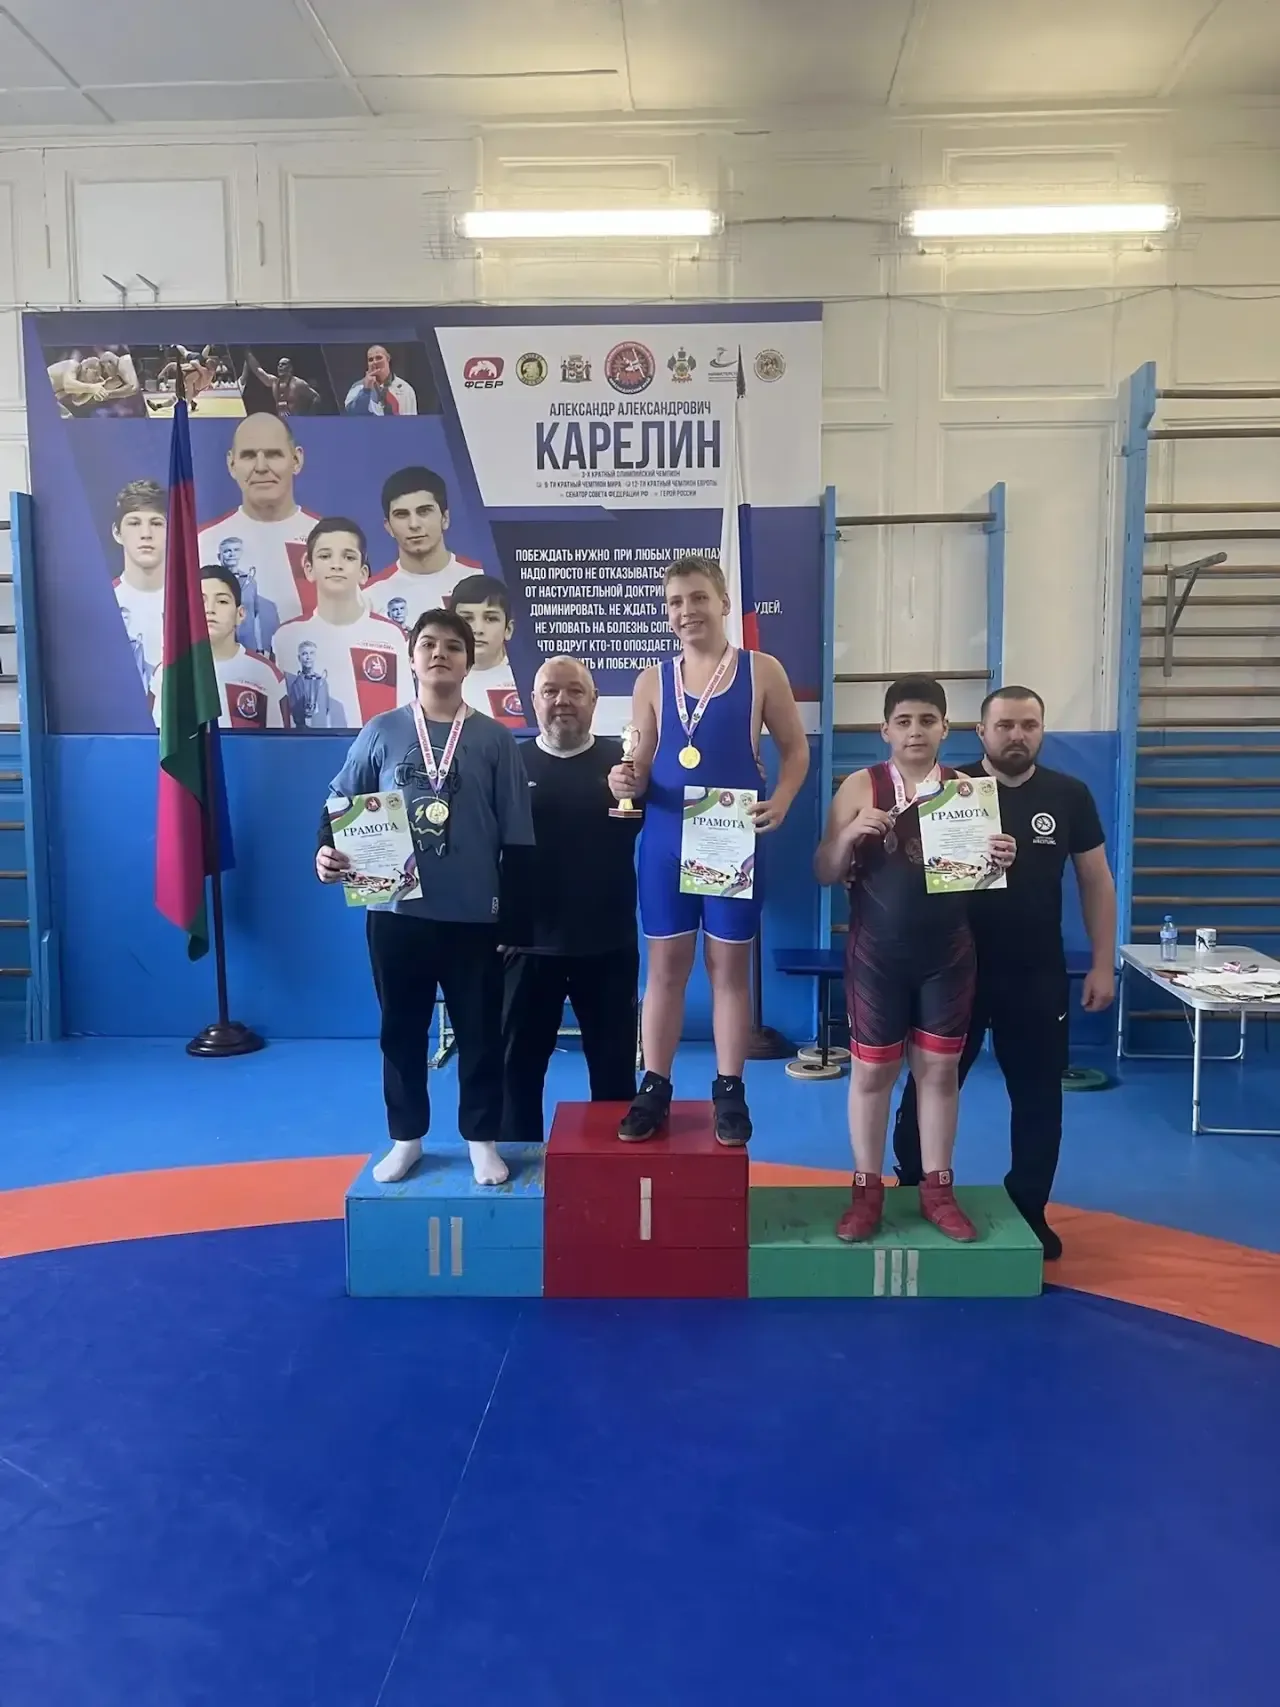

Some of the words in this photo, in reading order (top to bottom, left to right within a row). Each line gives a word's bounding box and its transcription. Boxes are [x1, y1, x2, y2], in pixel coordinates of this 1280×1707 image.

[464, 380, 504, 389] ФСБР
[550, 402, 615, 417] АЛЕКСАНДР
[618, 401, 711, 416] АЛЕКСАНДРОВИЧ
[536, 420, 721, 470] КАРЕЛИН
[592, 470, 615, 478] КРАТНЫЙ
[655, 469, 680, 477] ЧЕМПИОН
[557, 480, 581, 488] КРАТНЫЙ
[582, 480, 606, 488] ЧЕМПИОН
[607, 480, 621, 488] МИРА
[647, 479, 671, 487] КРАТНЫЙ
[671, 479, 696, 487] ЧЕМПИОН
[565, 490, 588, 498] СЕНАТОР
[588, 490, 608, 498] СОВЕТА
[608, 490, 640, 498] ФЕДЕРАЦИИ
[660, 488, 676, 497] ГЕРОЙ
[677, 489, 697, 497] РОССИИ
[515, 549, 573, 562] ПОБЕЖДАТЬ
[574, 548, 610, 561] НУЖНО
[614, 548, 633, 560] ПРИ
[634, 548, 671, 561] ЛЮБЫХ
[520, 567, 546, 580] НАДО
[548, 567, 583, 579] ПРОСТО
[585, 567, 597, 579] НЕ
[599, 566, 665, 579] ОТКАЗЫВАТЬС
[525, 586, 537, 598] ОТ
[538, 584, 623, 598] НАСТУПАТЕЛЬНОЙ
[530, 603, 607, 617] ДОМИНИРОВАТЬ.
[609, 603, 621, 615] НЕ
[623, 603, 657, 616] ЖДАТЬ
[754, 600, 783, 615] УДЕЙ,
[535, 622, 547, 634] НЕ
[548, 621, 591, 634] УПОВАТЬ
[593, 621, 605, 633] НА
[607, 621, 649, 633] БОЛЕЗНЬ
[537, 640, 554, 652] ЧТО
[556, 640, 587, 652] ВДРУГ
[589, 640, 621, 651] КТО-ТО
[623, 639, 672, 652] ОПОЗДАЕТ
[597, 658, 603, 669] И
[931, 808, 990, 821] ГРАМОТА
[692, 816, 745, 829] ГРАМОТА
[343, 822, 399, 837] ГРАМОТА
